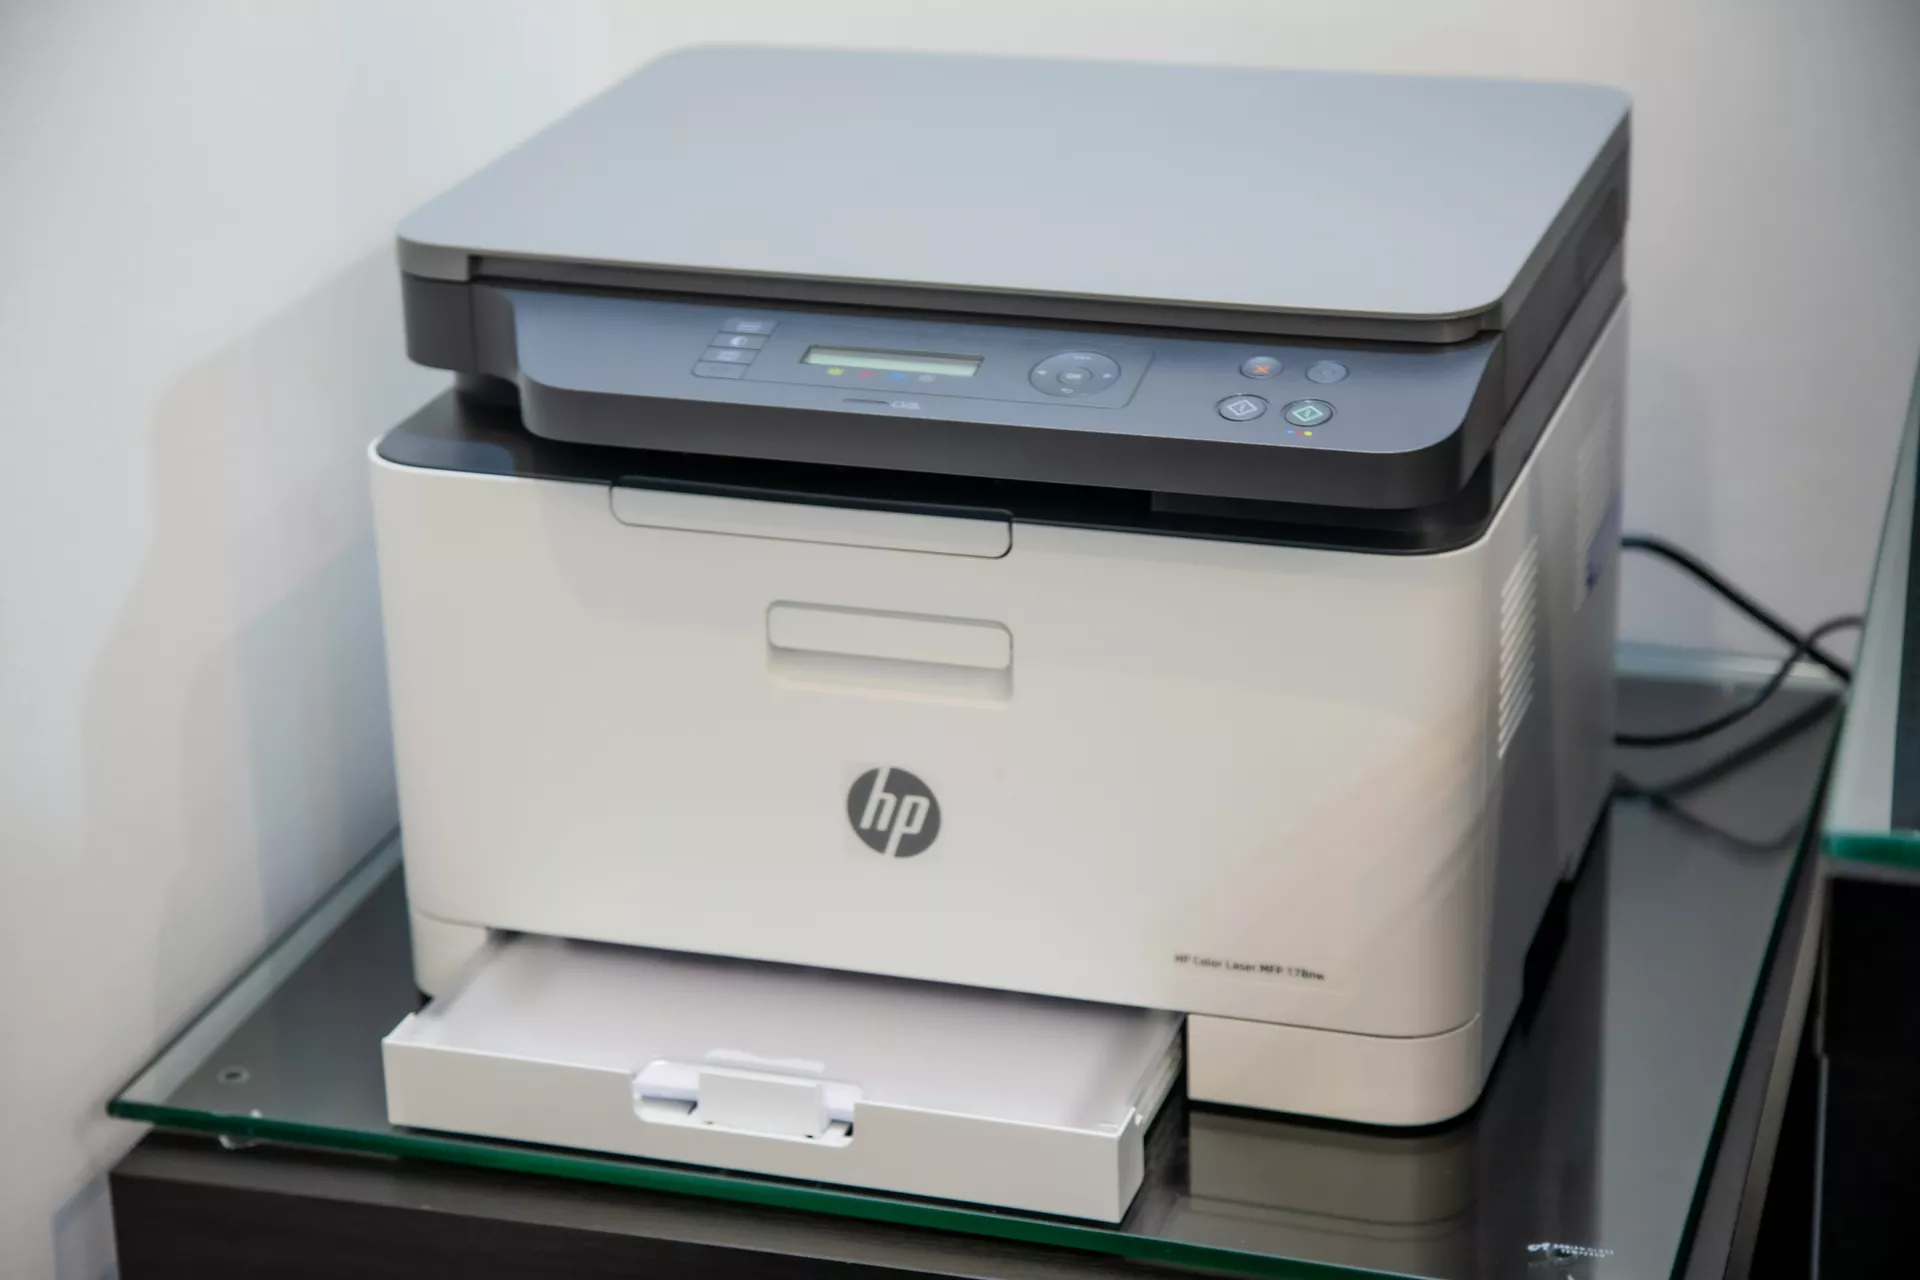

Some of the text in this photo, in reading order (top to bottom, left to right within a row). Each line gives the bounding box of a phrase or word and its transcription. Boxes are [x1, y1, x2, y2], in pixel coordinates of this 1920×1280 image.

[858, 767, 931, 858] hp
[1175, 954, 1189, 964] HP
[1192, 956, 1222, 967] Color
[1225, 960, 1255, 972] Laser
[1260, 963, 1283, 974] MFP
